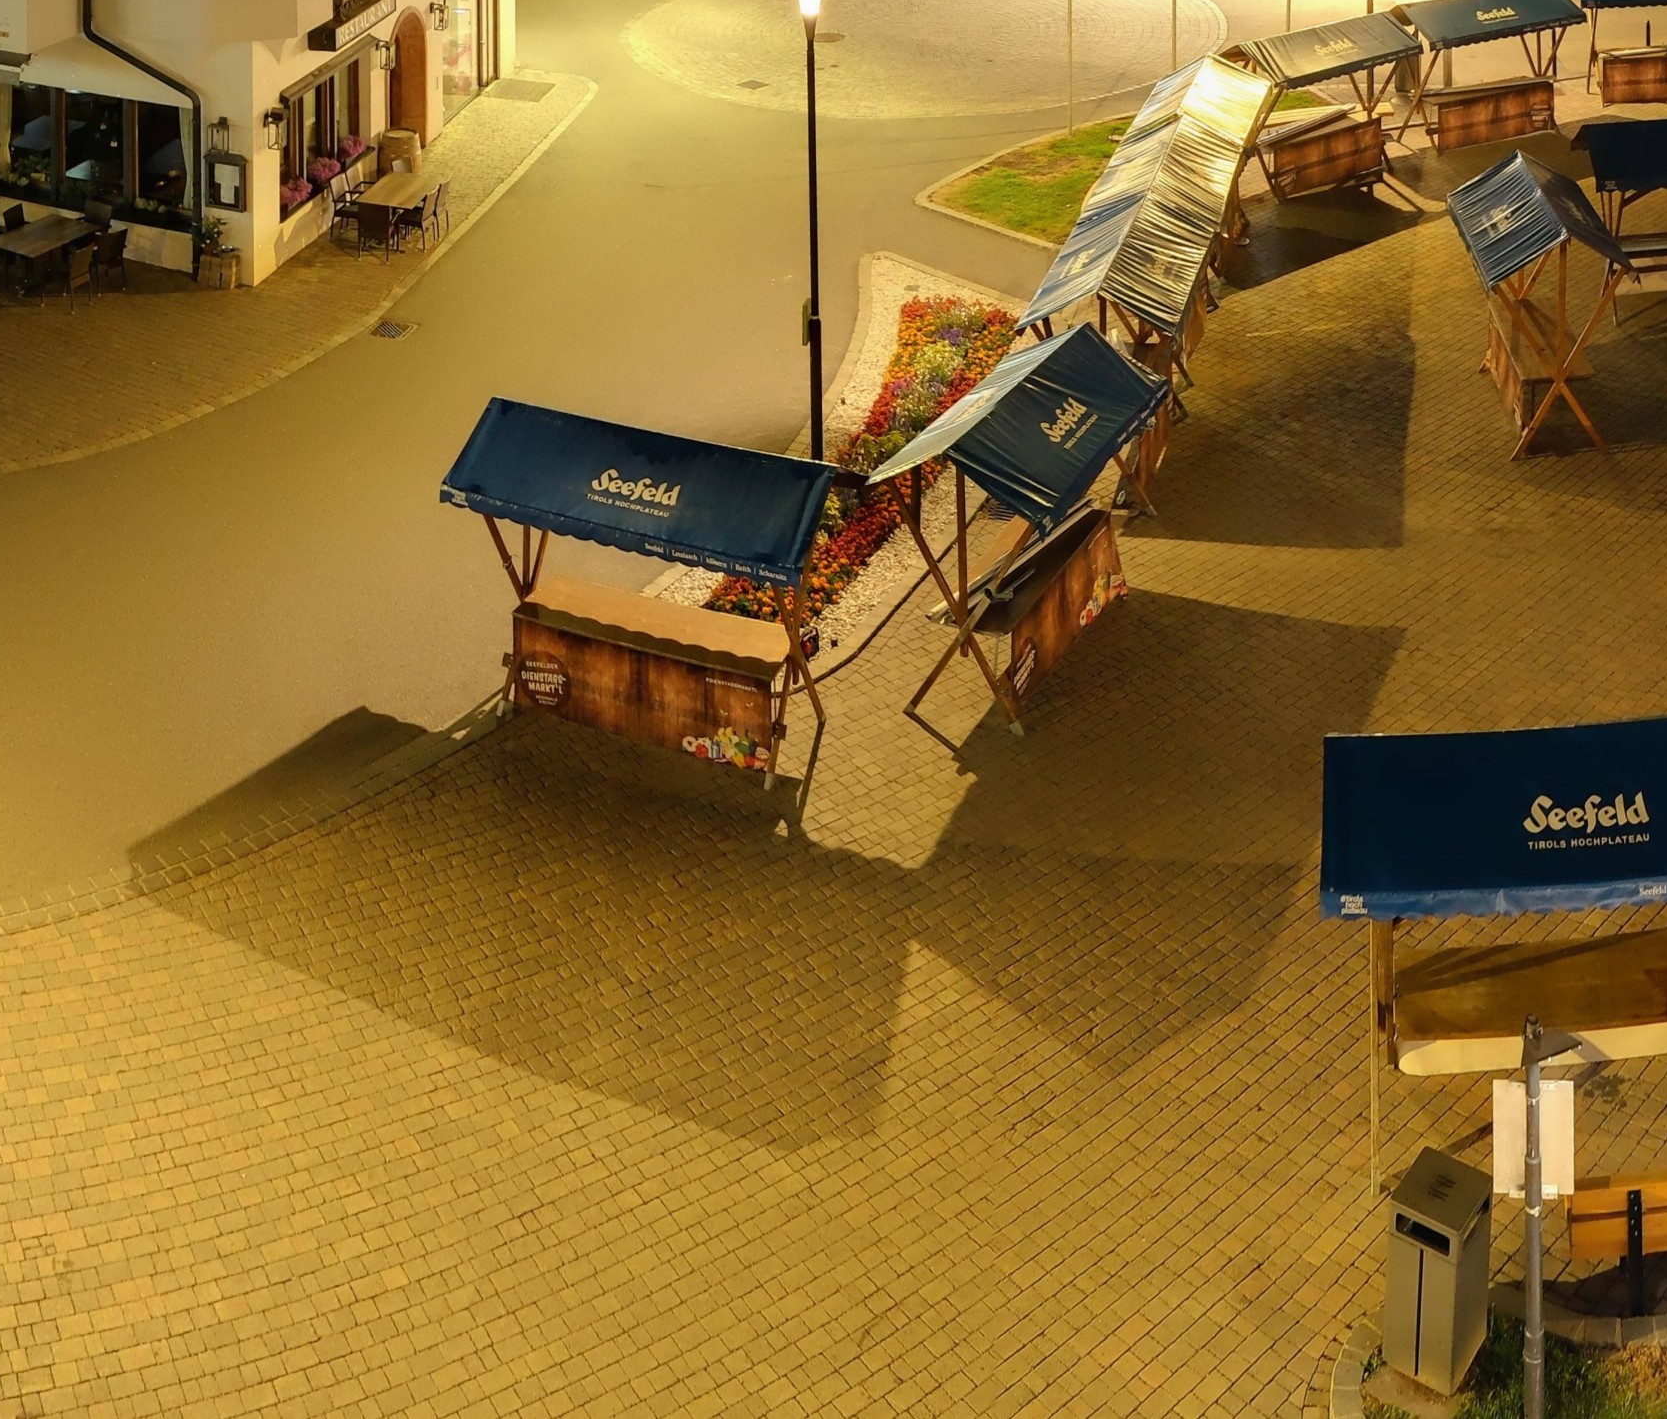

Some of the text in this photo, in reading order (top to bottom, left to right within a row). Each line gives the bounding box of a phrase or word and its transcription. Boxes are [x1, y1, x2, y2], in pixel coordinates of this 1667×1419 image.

[1476, 6, 1516, 22] Seefeld
[1314, 38, 1354, 57] Seefeld
[1039, 397, 1088, 444] Seefeld
[590, 468, 682, 507] Seefeld
[586, 492, 670, 518] TIROLS HOCHPLATEAU
[525, 660, 560, 670] SEEFELDER
[521, 669, 567, 685] DIENSTAGS-
[528, 680, 564, 695] MARKT'L
[1523, 791, 1650, 835] Seefeld
[1527, 833, 1651, 851] TIROLS HOCHPLATEAU
[1639, 884, 1667, 898] Seefeld
